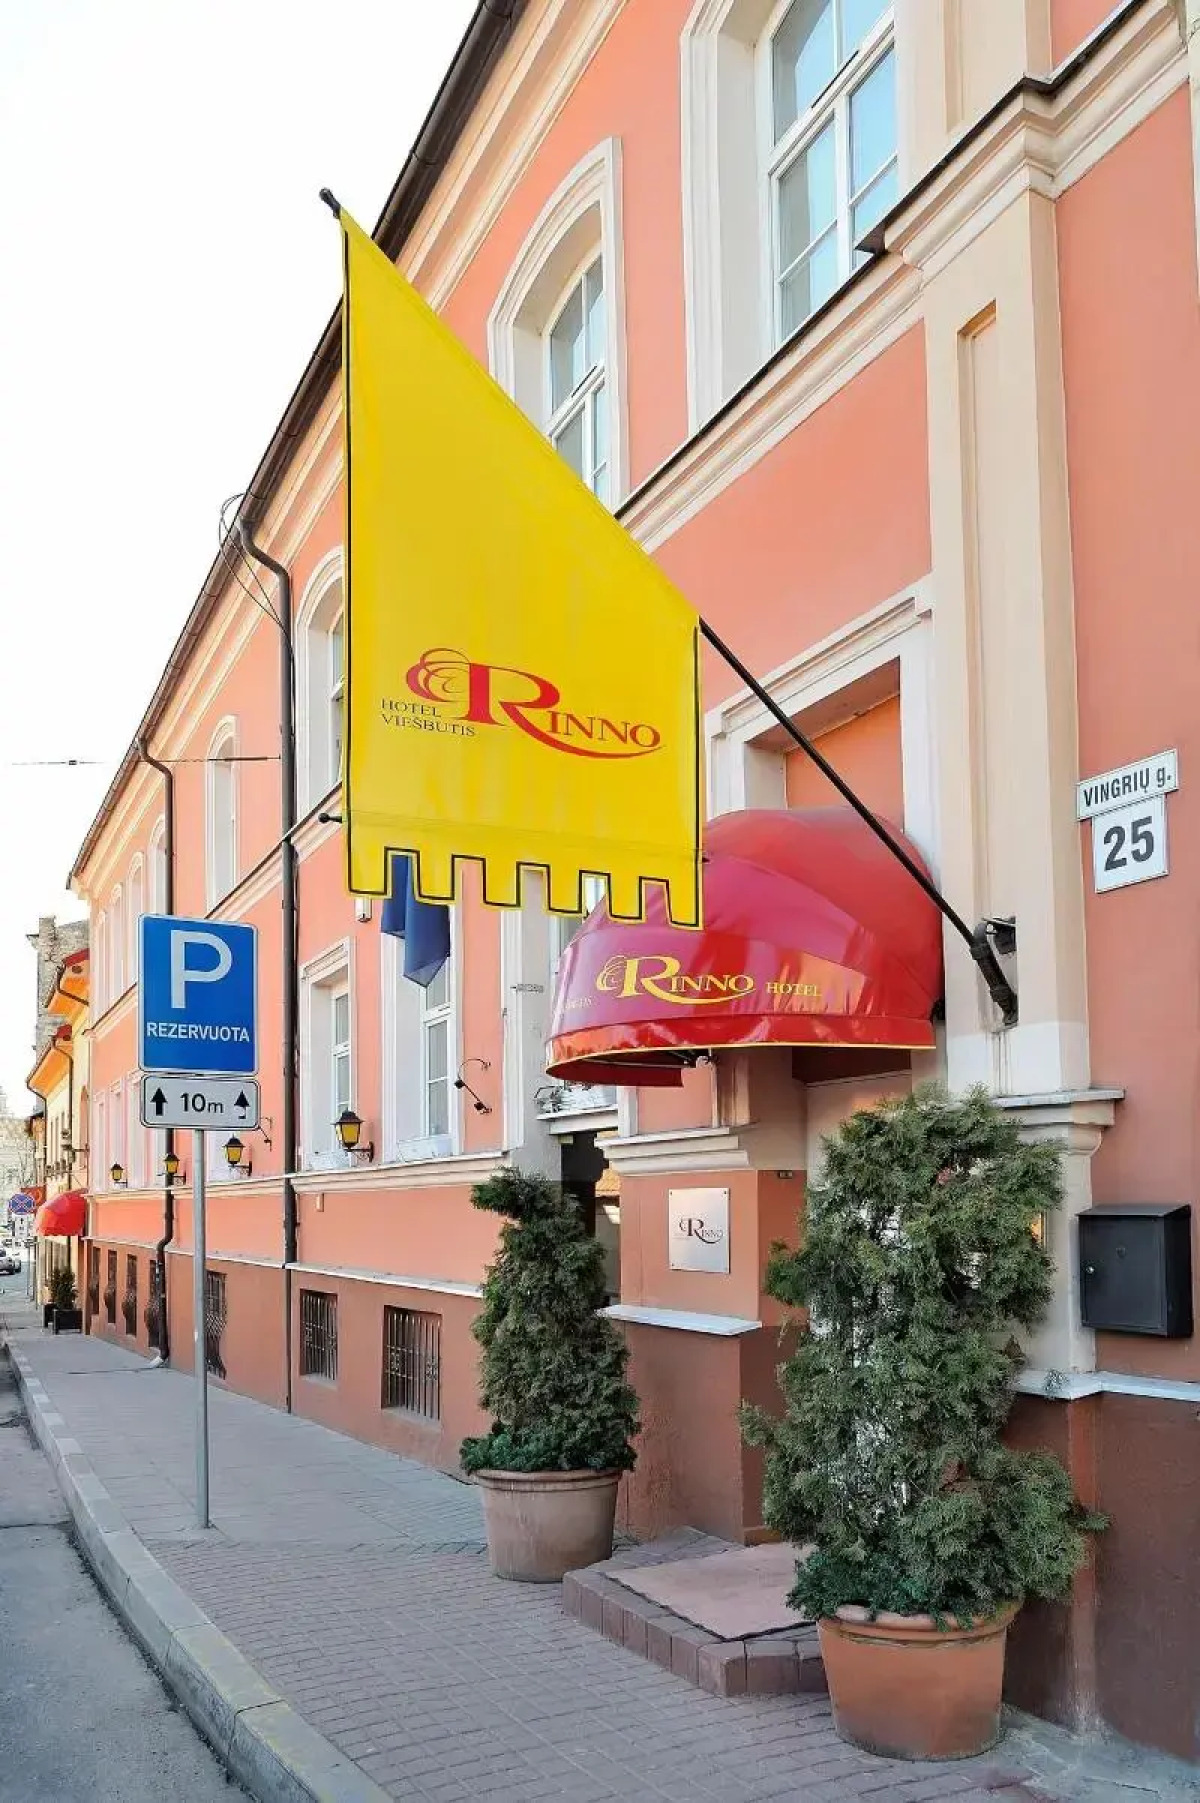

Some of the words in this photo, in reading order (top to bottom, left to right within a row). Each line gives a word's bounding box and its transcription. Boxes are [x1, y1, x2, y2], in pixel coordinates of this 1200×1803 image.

[381, 697, 442, 718] HOTEL
[406, 647, 669, 759] RINNO
[1083, 767, 1150, 807] VINGRIŲ
[1156, 767, 1171, 789] g.
[1103, 815, 1155, 872] 25
[170, 929, 232, 1009] P
[596, 954, 756, 1005] RINNO
[766, 982, 822, 997] HOTEL
[146, 1022, 250, 1042] REZERVUOTA
